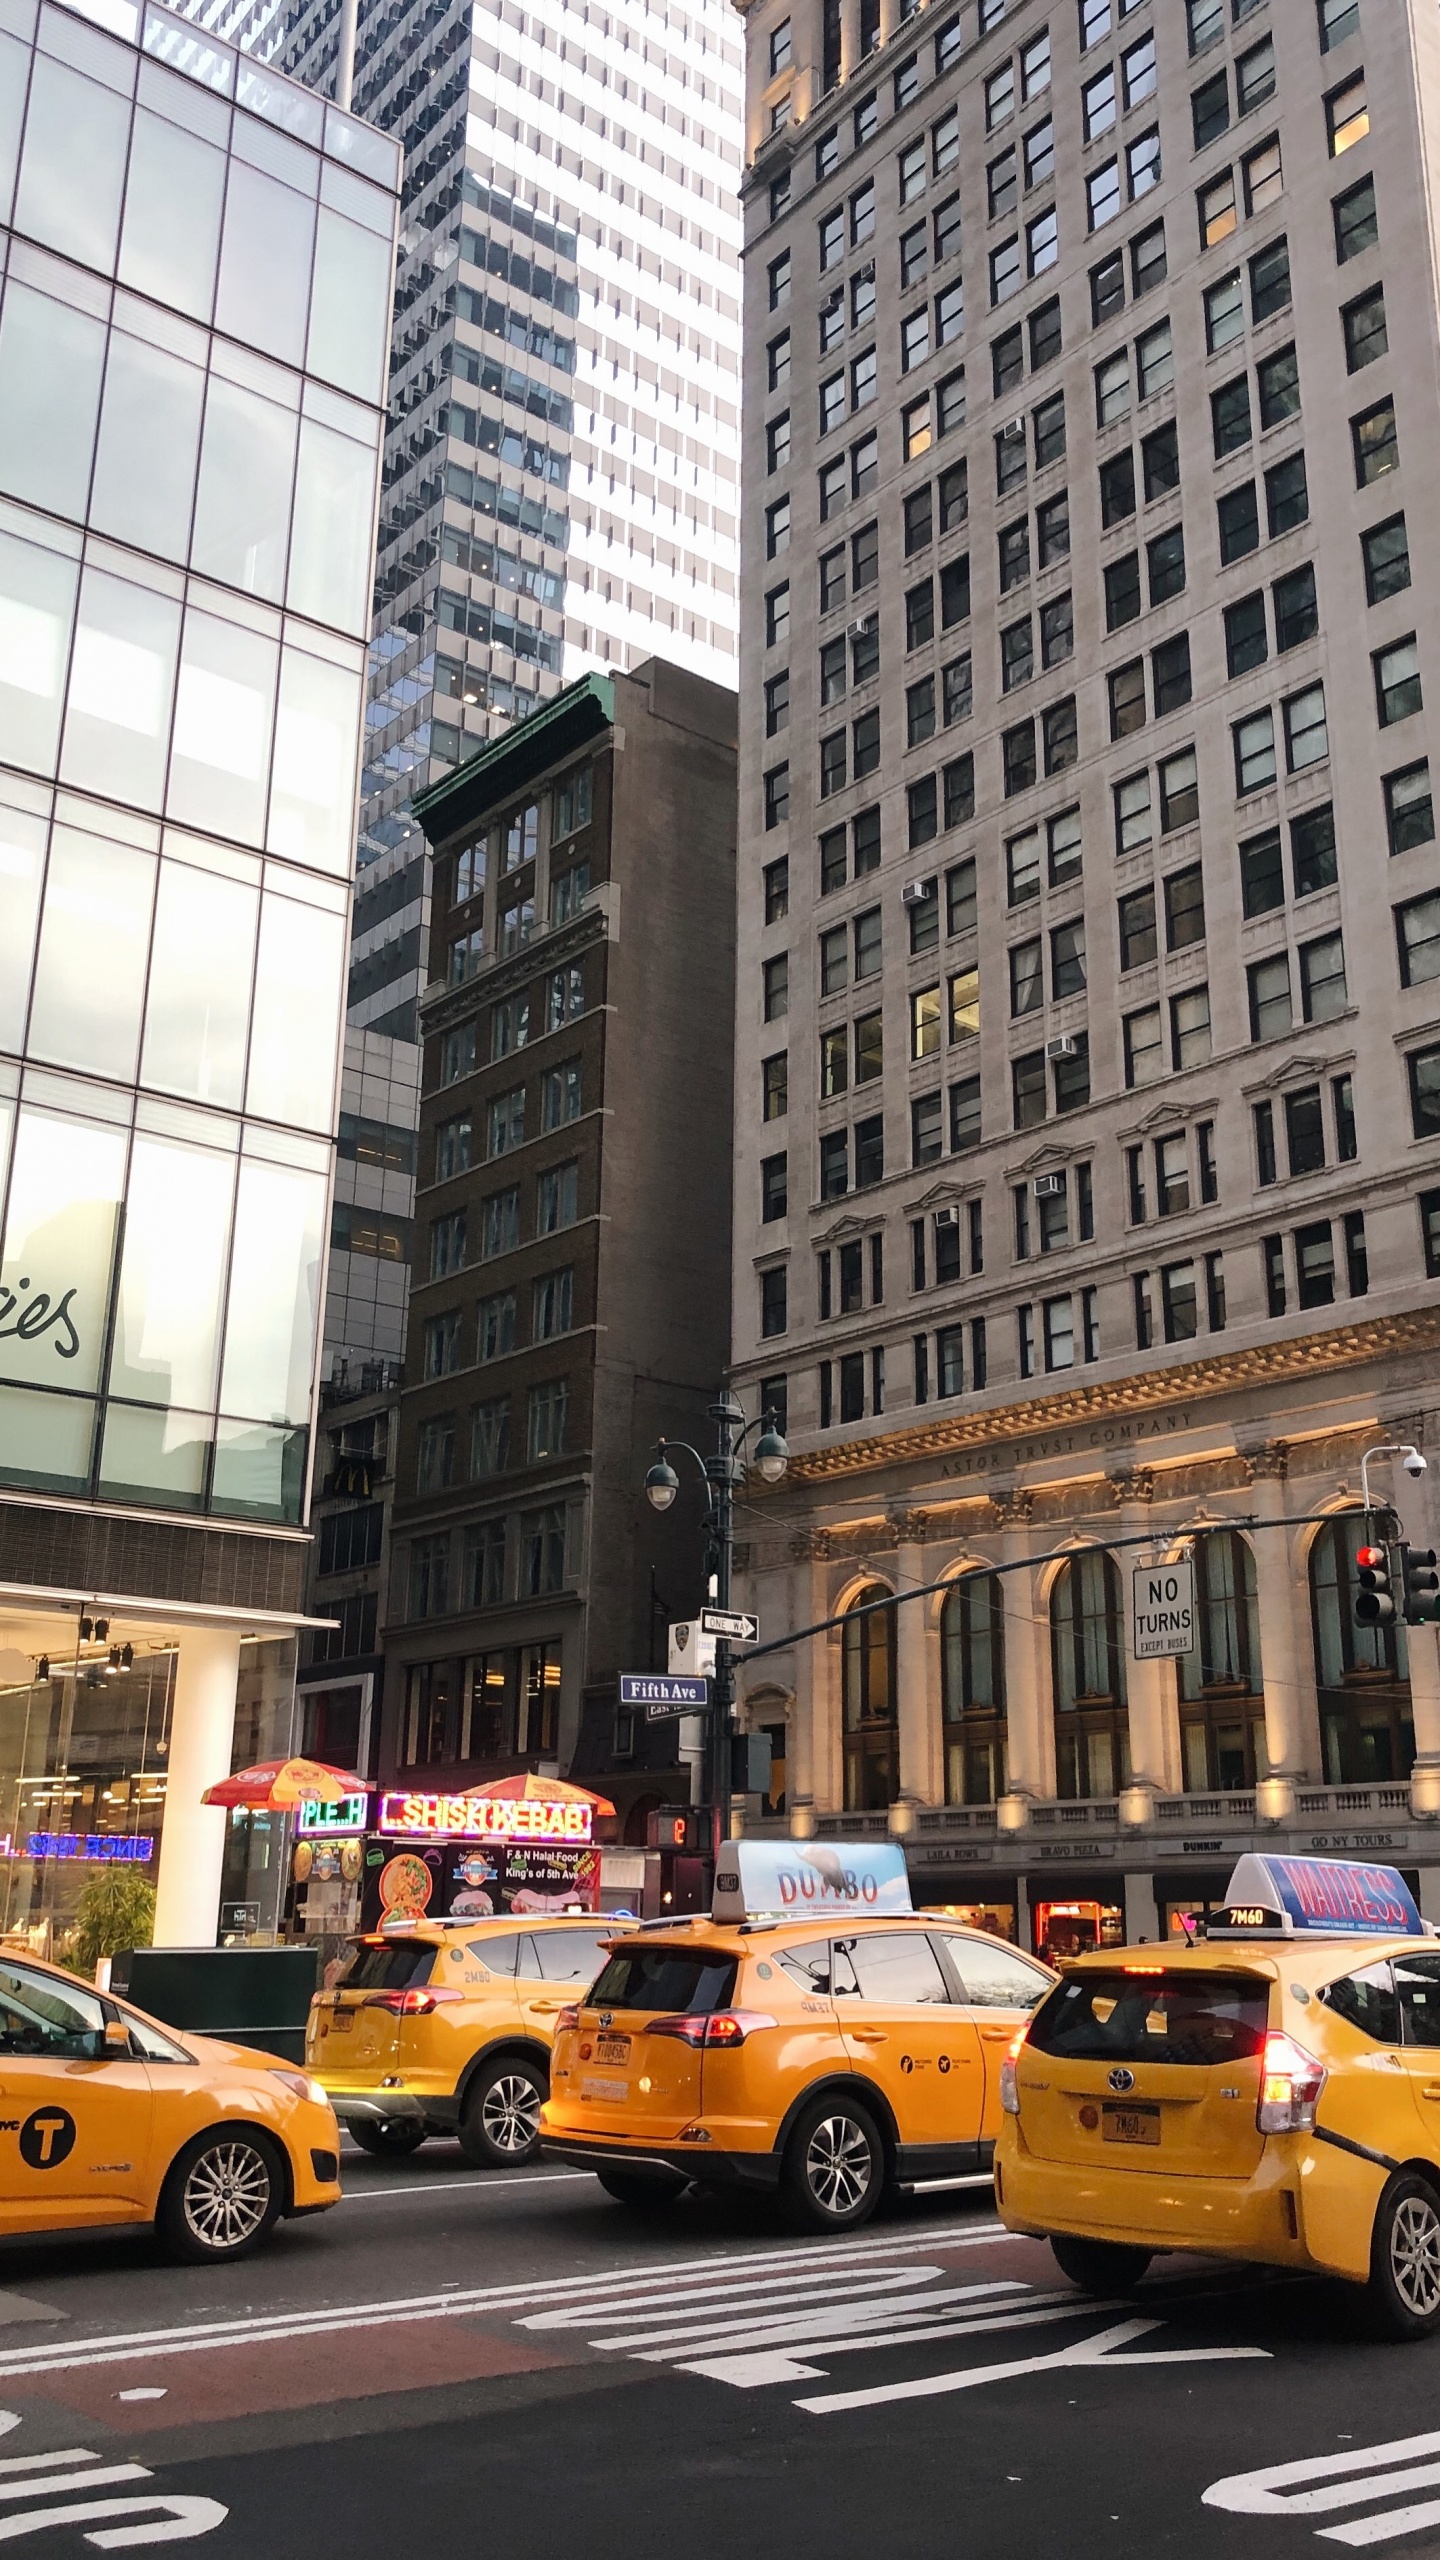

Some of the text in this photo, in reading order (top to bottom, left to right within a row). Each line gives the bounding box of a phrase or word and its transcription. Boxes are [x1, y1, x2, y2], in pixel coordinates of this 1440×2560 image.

[940, 1412, 1192, 1477] ASTOR TRVST COMPANY
[1149, 1577, 1178, 1604] NO
[709, 1617, 750, 1633] ONE WAY
[1136, 1609, 1191, 1635] TURNS
[1140, 1637, 1188, 1653] EXCEPT BUSES
[630, 1681, 697, 1699] Fifth Ave
[492, 1802, 584, 1834] KEBAB
[1183, 1841, 1223, 1852] DUNKIN'
[1311, 1834, 1393, 1848] GO NY TOURS
[507, 1849, 513, 1860] F
[514, 1850, 521, 1860] &
[524, 1850, 531, 1860] N
[532, 1850, 555, 1861] Halal
[556, 1851, 579, 1862] Food
[1040, 1844, 1101, 1857] BRAVO PIZZA
[572, 1851, 592, 1873] SINCE
[505, 1867, 579, 1880] King's of 5th Ave
[1279, 1857, 1409, 1926] WAITRESS
[1229, 1908, 1264, 1925] 7M60
[34, 2118, 65, 2162] T
